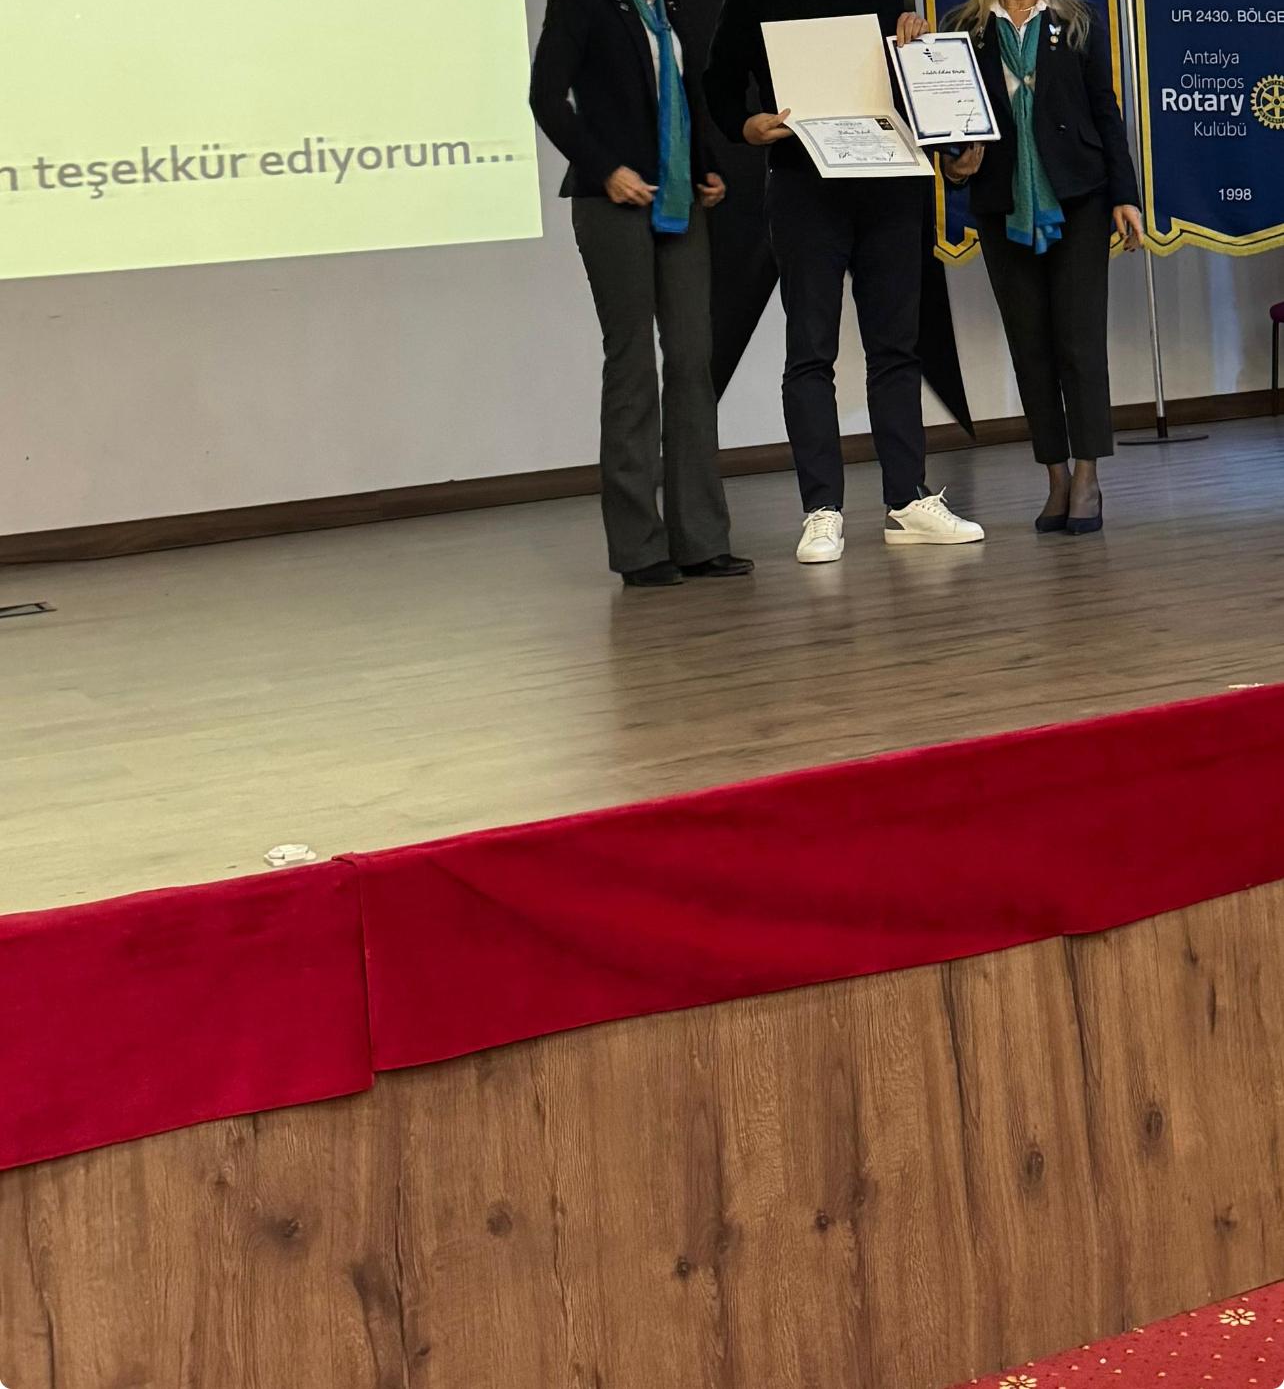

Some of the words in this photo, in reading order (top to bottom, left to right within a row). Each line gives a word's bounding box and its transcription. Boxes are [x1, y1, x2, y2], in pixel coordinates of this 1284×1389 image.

[1171, 10, 1193, 23] UR
[1196, 10, 1233, 23] 2430.
[1237, 7, 1284, 23] BÖLGE
[1183, 49, 1240, 69] Antalya
[1180, 73, 1244, 93] Olimpos
[1161, 88, 1245, 116] Rotary
[1194, 121, 1247, 137] Kulübü
[32, 143, 248, 199] teşekkür
[259, 137, 514, 184] ediyorum...
[1218, 188, 1252, 201] 1998
